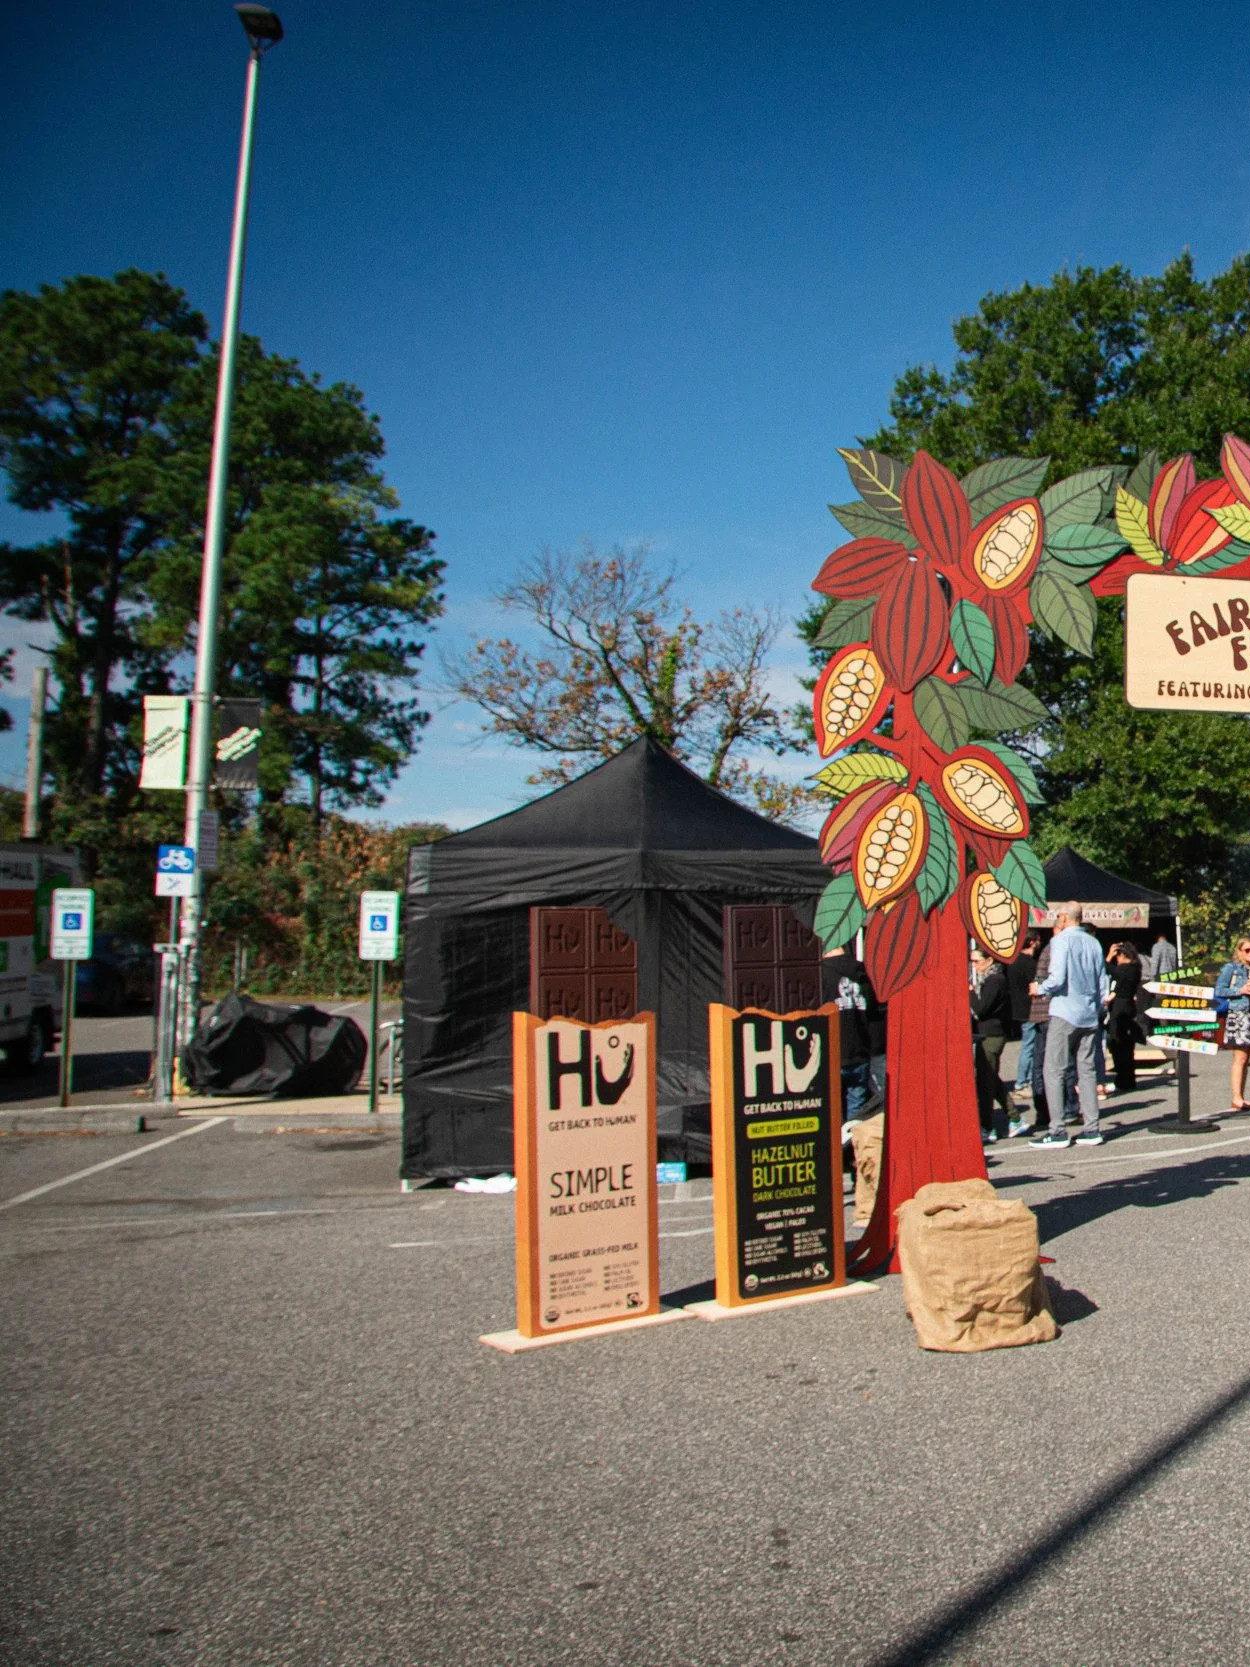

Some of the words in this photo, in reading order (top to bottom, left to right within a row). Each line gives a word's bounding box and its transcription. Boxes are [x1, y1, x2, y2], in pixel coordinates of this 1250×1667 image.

[1160, 966, 1201, 982] MURAL
[1160, 984, 1204, 996] MERCH
[744, 1104, 759, 1115] GET
[760, 1101, 782, 1113] BACK
[782, 1100, 793, 1111] TO
[548, 1121, 565, 1132] GET
[567, 1118, 590, 1130] BACK
[593, 1116, 604, 1127] TO
[751, 1141, 815, 1164] HAZELNUT
[550, 1163, 633, 1198] SIMPLE
[752, 1161, 816, 1188] BUTTER
[752, 1190, 773, 1203] DARK
[774, 1184, 816, 1199] CHOCOLATE
[549, 1203, 576, 1216] MILK
[579, 1196, 636, 1213] CHOCOLATE
